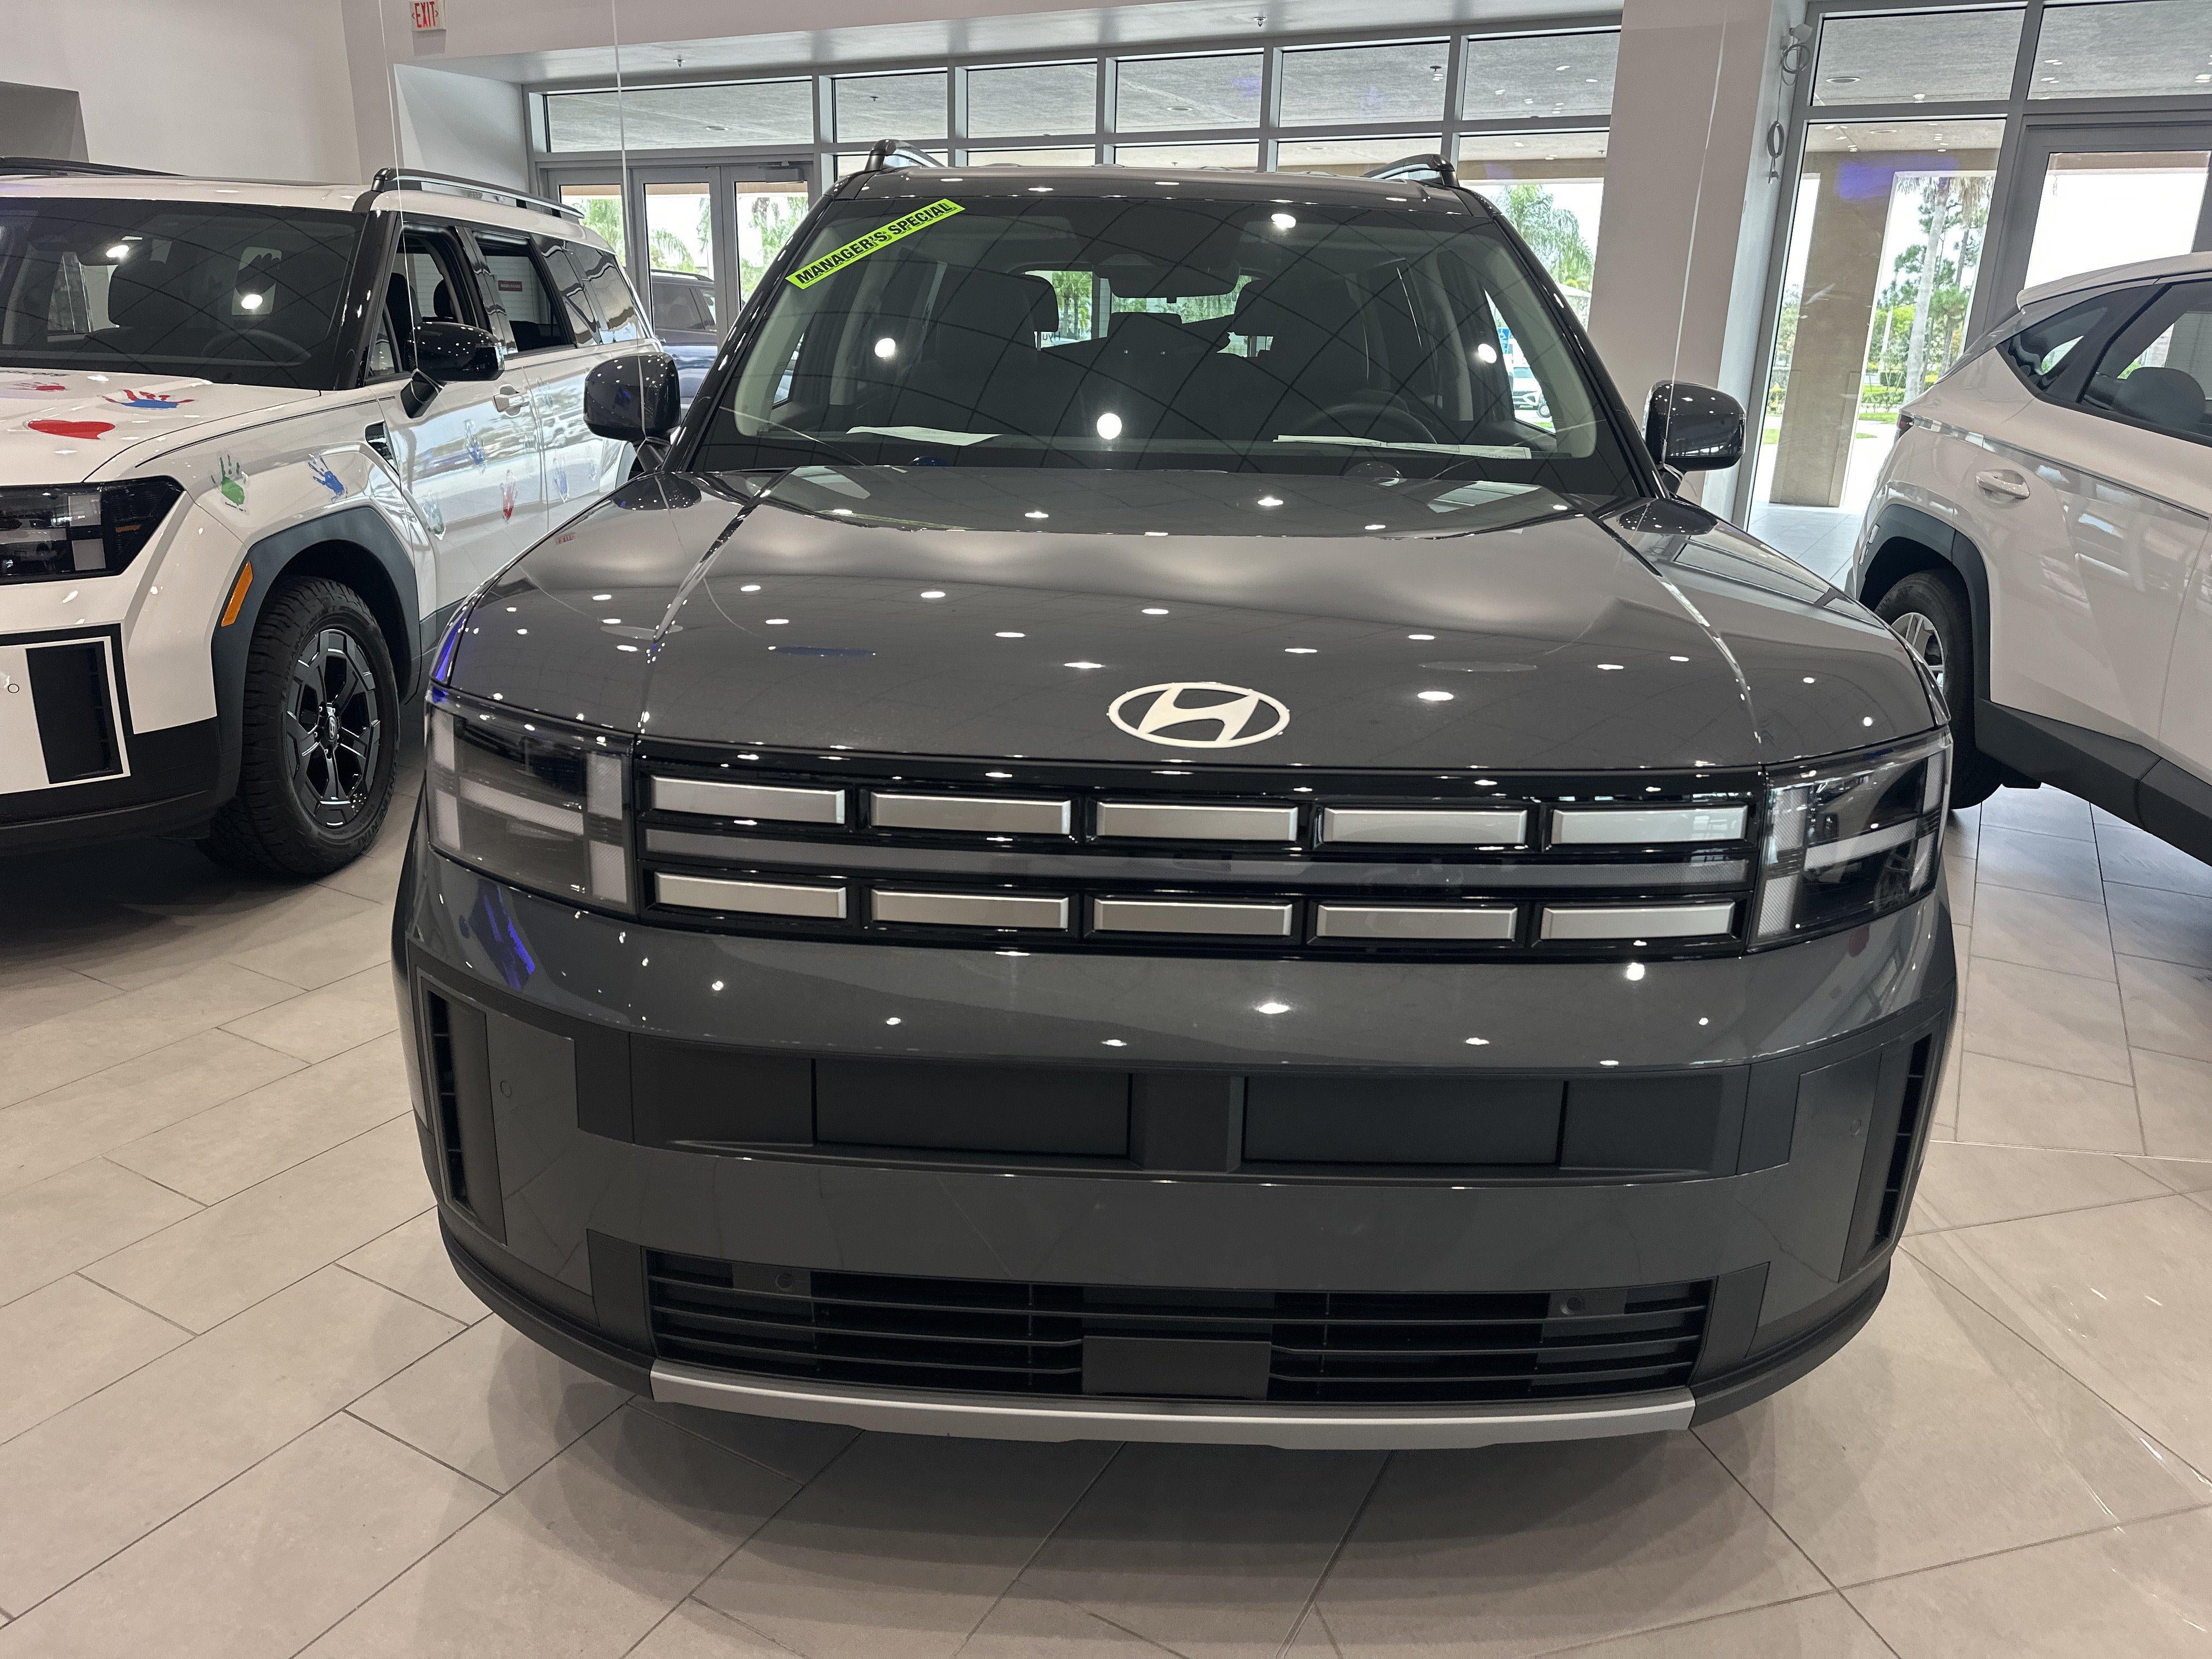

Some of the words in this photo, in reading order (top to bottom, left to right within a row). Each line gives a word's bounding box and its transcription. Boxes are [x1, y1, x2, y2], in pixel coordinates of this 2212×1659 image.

[414, 1, 436, 28] EXIT
[794, 231, 888, 284] MANAGER'S
[888, 201, 954, 235] SPECIAL
